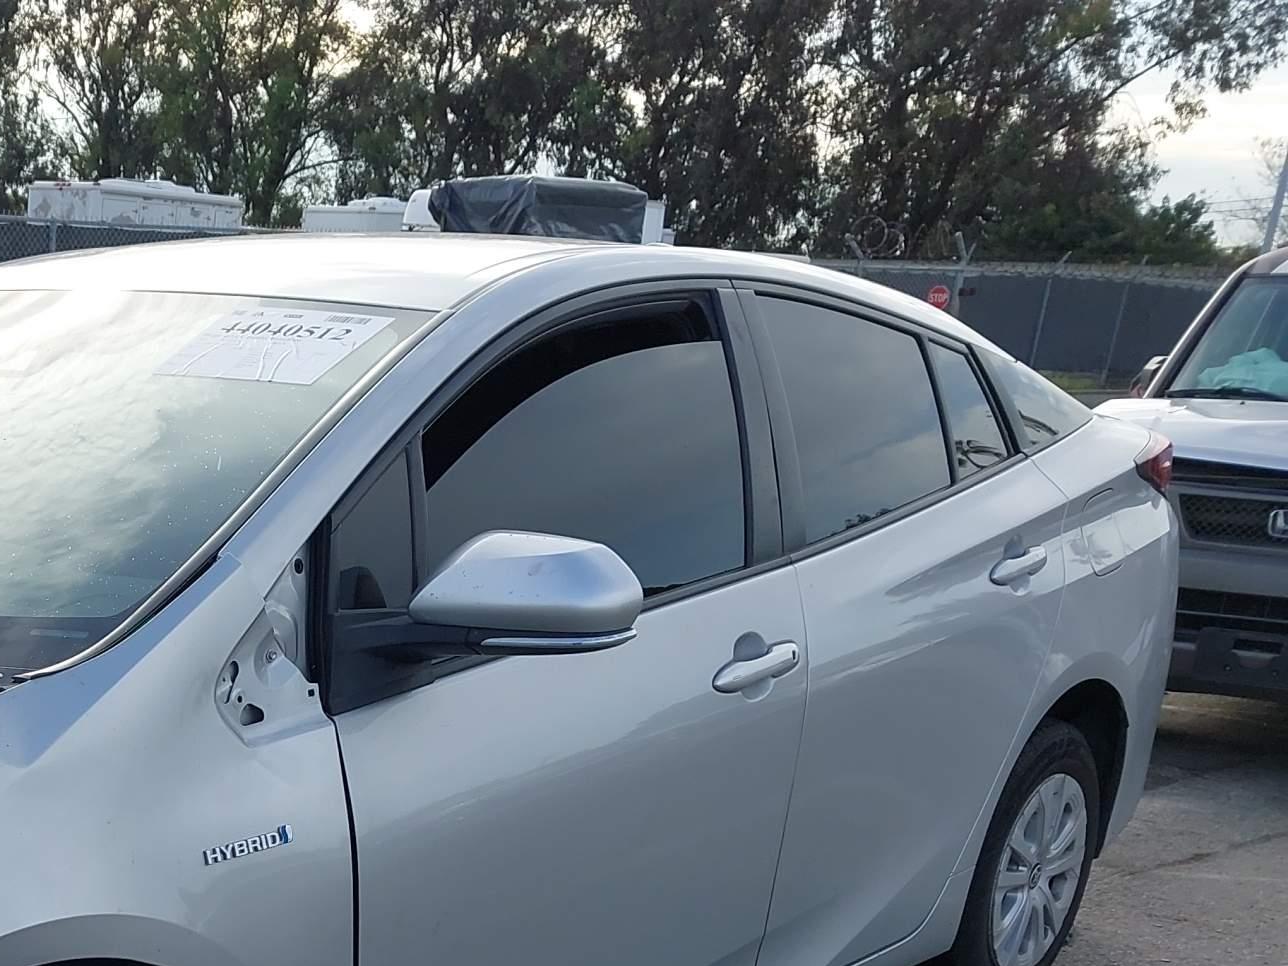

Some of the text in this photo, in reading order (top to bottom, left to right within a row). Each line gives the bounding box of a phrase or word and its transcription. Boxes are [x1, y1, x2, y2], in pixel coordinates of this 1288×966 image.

[929, 293, 949, 303] STOP
[221, 320, 352, 341] 44040512
[203, 832, 281, 866] HYBRID
